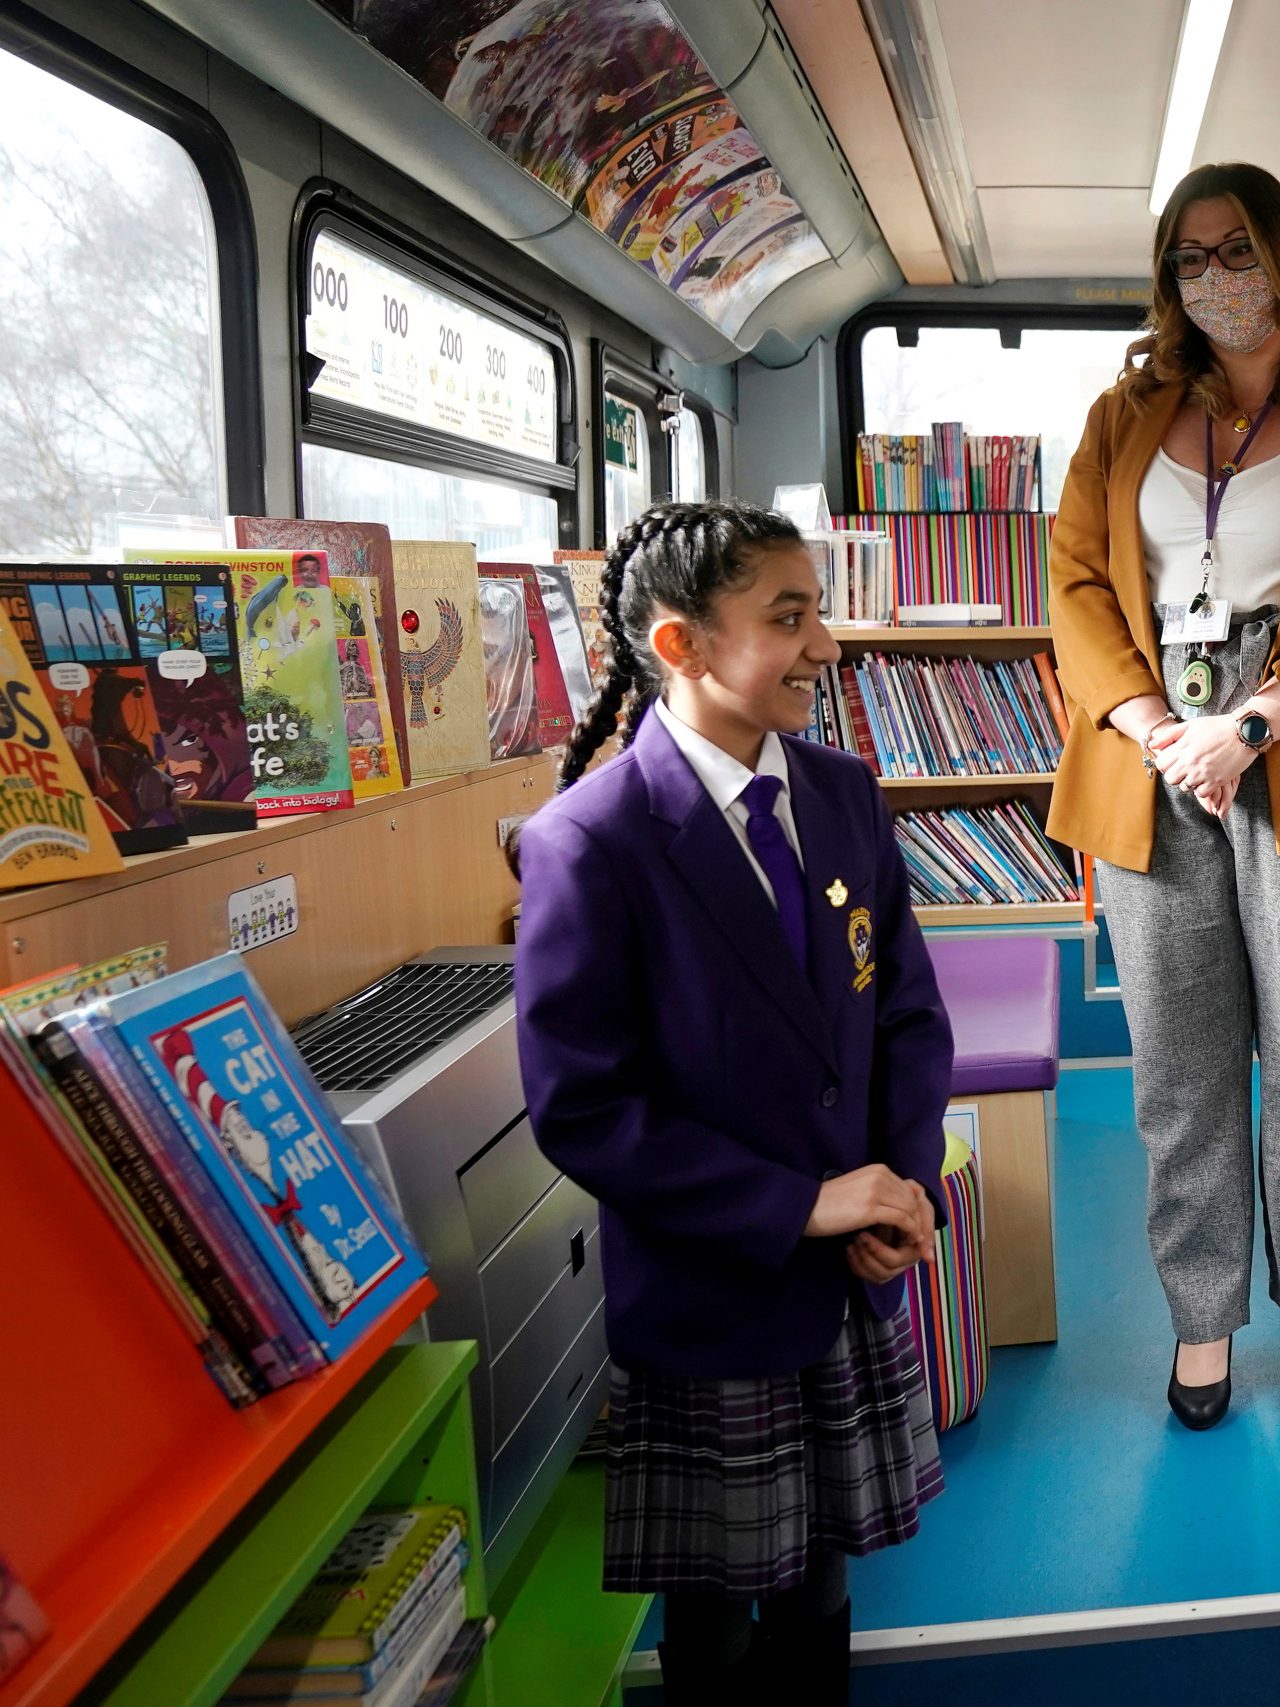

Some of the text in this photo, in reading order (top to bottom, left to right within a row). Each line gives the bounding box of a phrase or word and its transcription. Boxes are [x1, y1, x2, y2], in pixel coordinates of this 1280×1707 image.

[626, 140, 656, 181] EVER
[313, 261, 348, 312] 000
[383, 294, 408, 339] 100
[439, 323, 463, 365] 200
[485, 344, 506, 381] 300
[527, 363, 546, 397] 400
[123, 573, 201, 582] GRAPHIC LEGENDS
[229, 561, 284, 573] WINSTON
[570, 563, 598, 577] KING
[246, 713, 299, 743] at's
[251, 747, 285, 778] fe
[256, 793, 340, 811] back into biology!
[221, 1028, 249, 1050] THE
[225, 1044, 276, 1095] CAT
[269, 1111, 301, 1140] THE
[70, 1065, 102, 1104] ALICE
[92, 1099, 140, 1161] THROUGH
[145, 1179, 189, 1236] LOOKING
[278, 1130, 332, 1188] HAT
